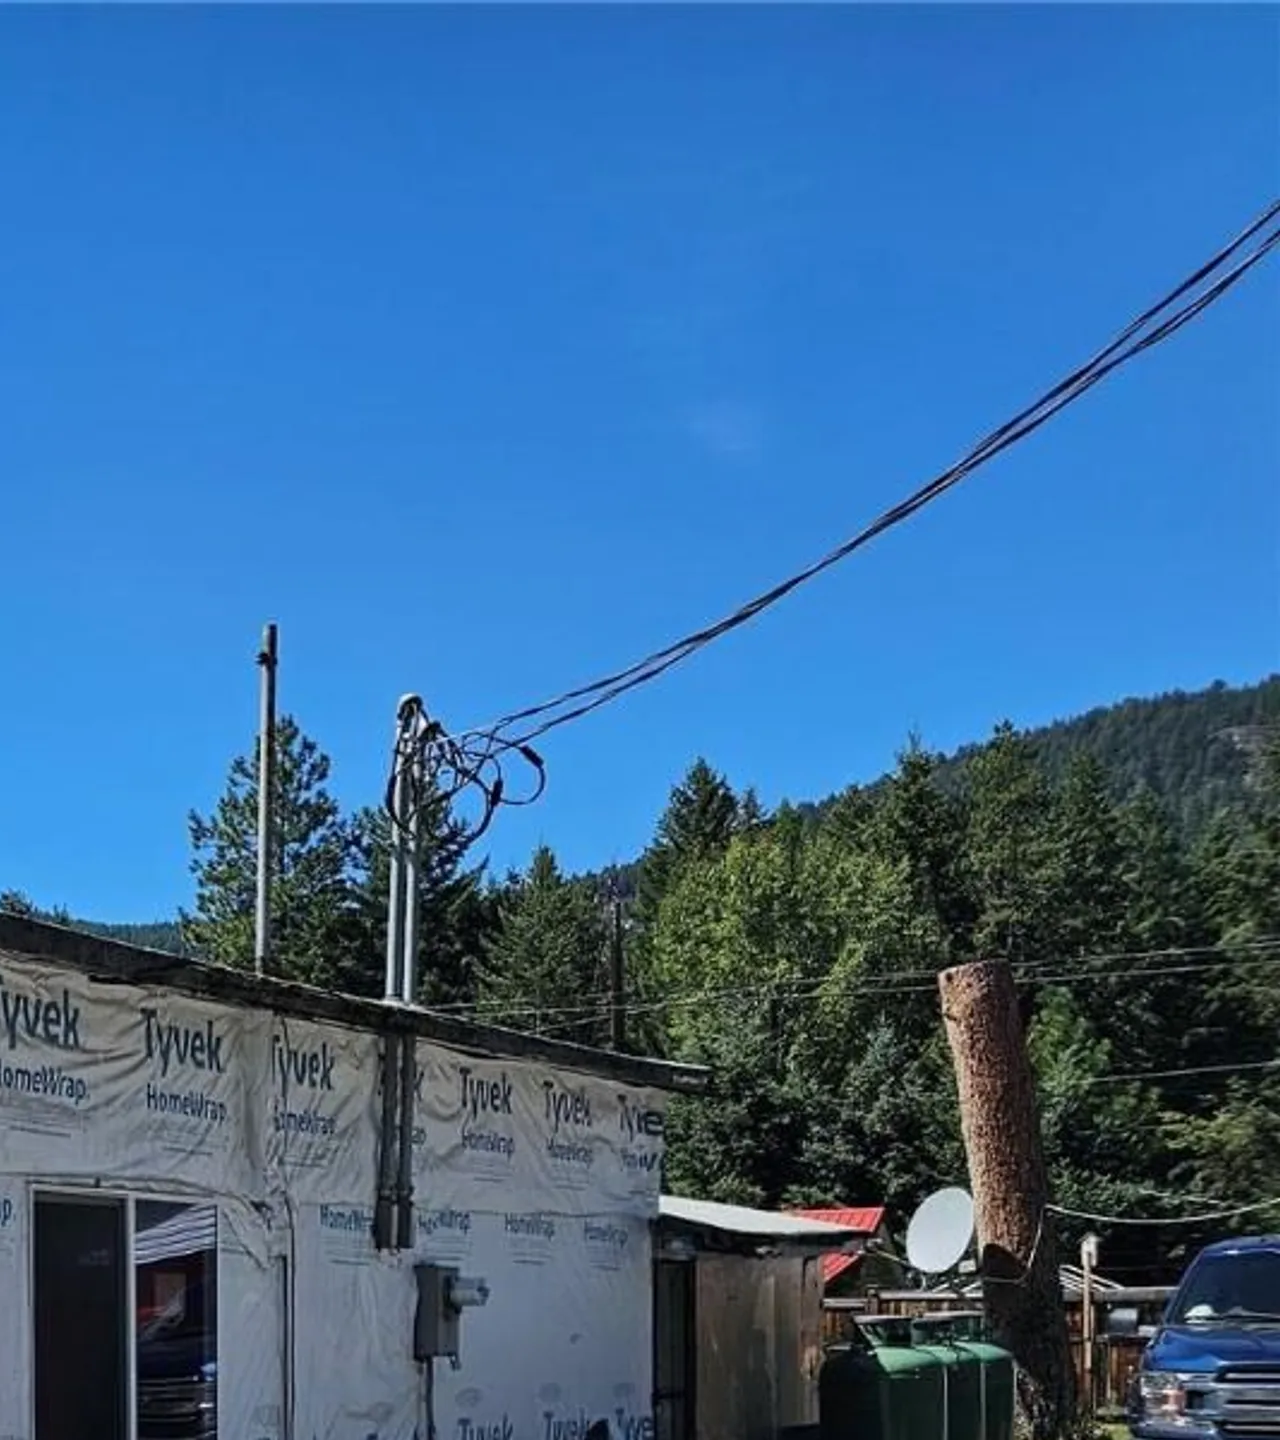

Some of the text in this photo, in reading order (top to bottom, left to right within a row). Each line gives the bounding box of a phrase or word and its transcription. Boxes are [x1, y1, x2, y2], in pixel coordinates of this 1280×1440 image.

[140, 1008, 223, 1077] Tyvek
[147, 1083, 227, 1125] HomeWrap
[460, 1067, 512, 1122] Tyvek
